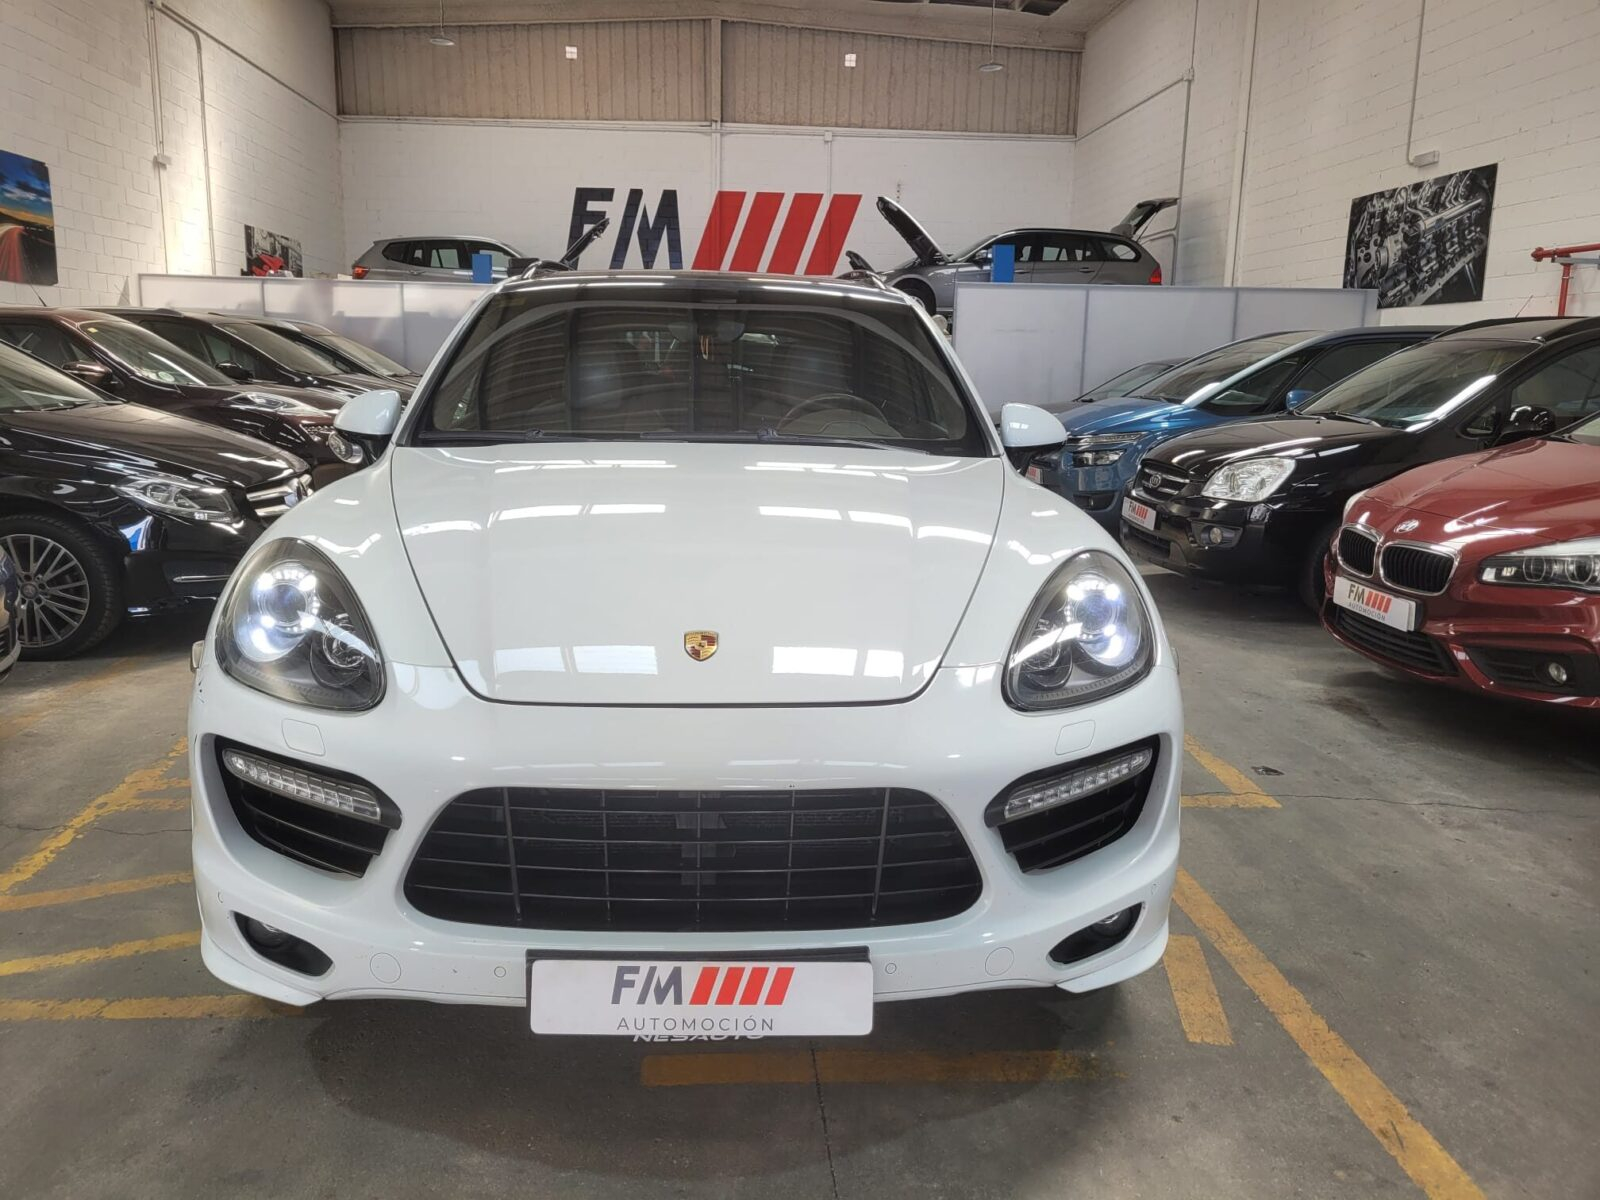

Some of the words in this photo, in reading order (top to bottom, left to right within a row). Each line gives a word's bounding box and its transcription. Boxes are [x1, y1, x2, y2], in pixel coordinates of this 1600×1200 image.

[567, 187, 683, 270] FM
[1348, 583, 1365, 605] FM
[611, 966, 683, 1005] FM
[617, 1015, 774, 1031] AUTOMOCIÓN
